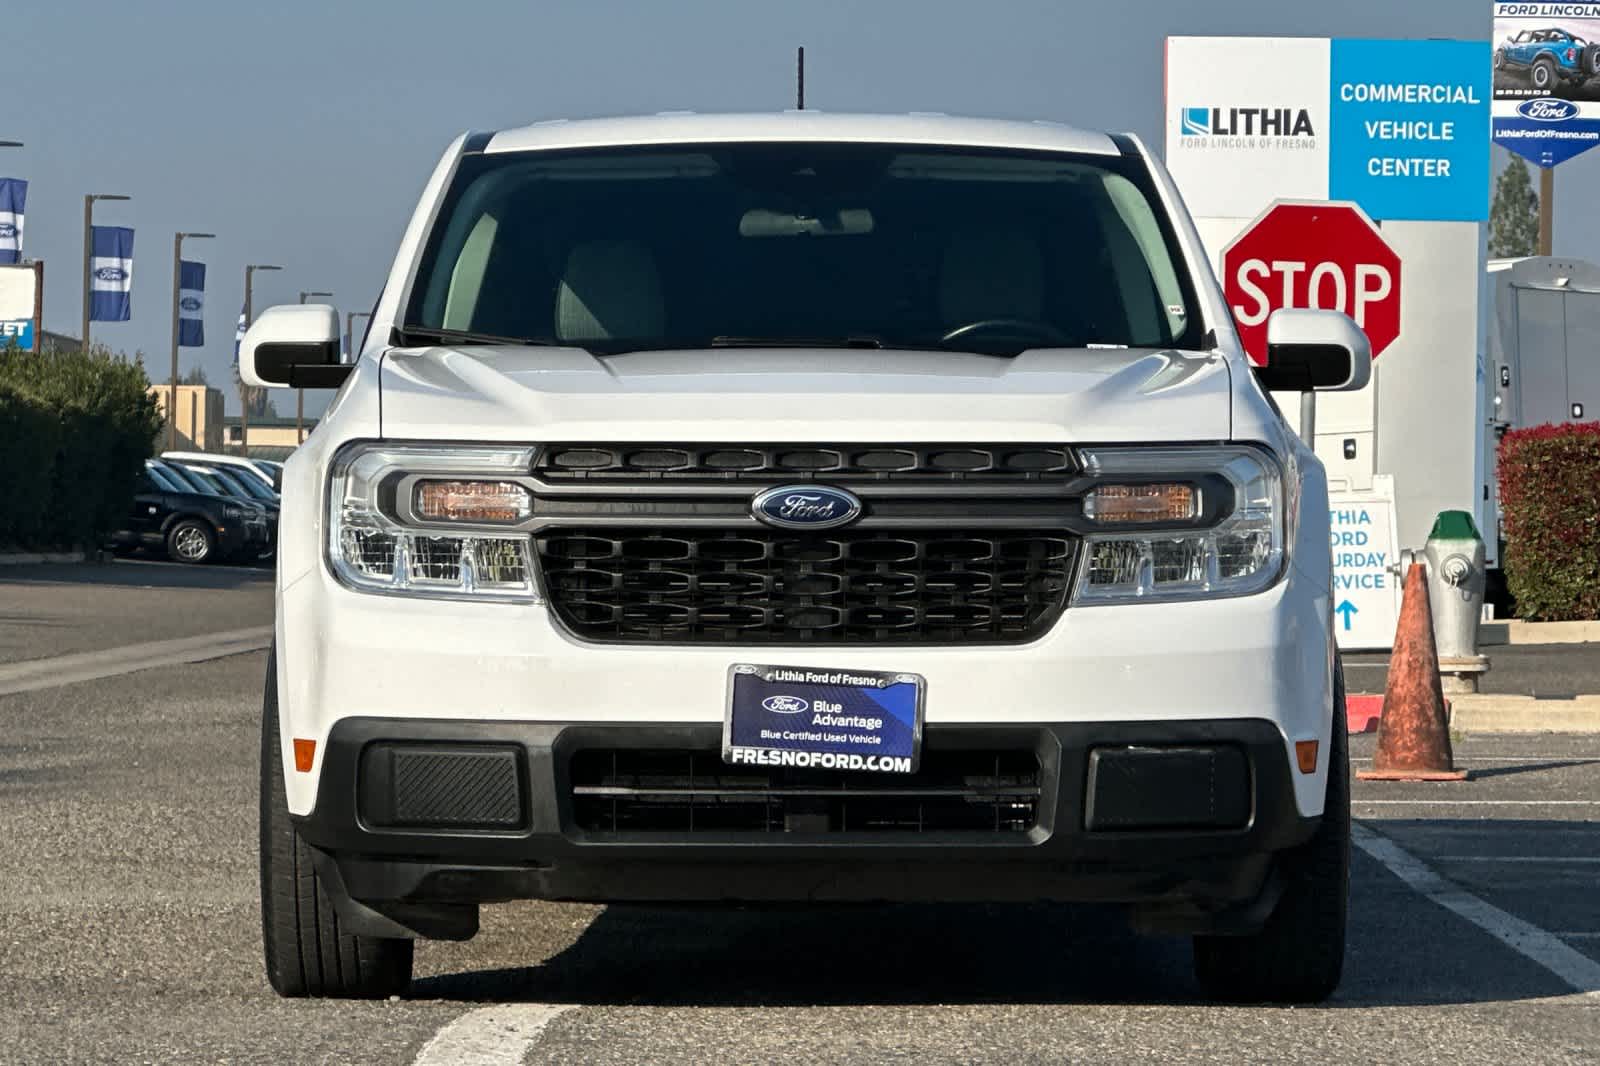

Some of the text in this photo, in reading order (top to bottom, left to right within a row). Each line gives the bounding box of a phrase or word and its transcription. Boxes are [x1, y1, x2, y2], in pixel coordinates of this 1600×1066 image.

[1499, 4, 1600, 16] FORD LINCOLN
[1340, 83, 1481, 104] COMMERCIAL
[1528, 101, 1568, 118] Ford
[1212, 107, 1315, 136] LITHIA
[1364, 120, 1454, 140] VEHICLE
[1495, 129, 1599, 140] LithiaFordOfFresno.com
[1181, 138, 1316, 150] FORD LINCOLN OF FRESNO
[1367, 157, 1451, 177] CENTER
[1234, 258, 1392, 328] STOP
[780, 494, 835, 518] Ford
[775, 670, 877, 687] Lithia Ford of Fresno
[770, 697, 800, 711] Ford
[813, 701, 843, 713] Blue
[812, 713, 883, 731] Advantage
[760, 729, 882, 745] Blue Certified Used Vehicle
[732, 749, 911, 773] FRESNOFORD.COM
